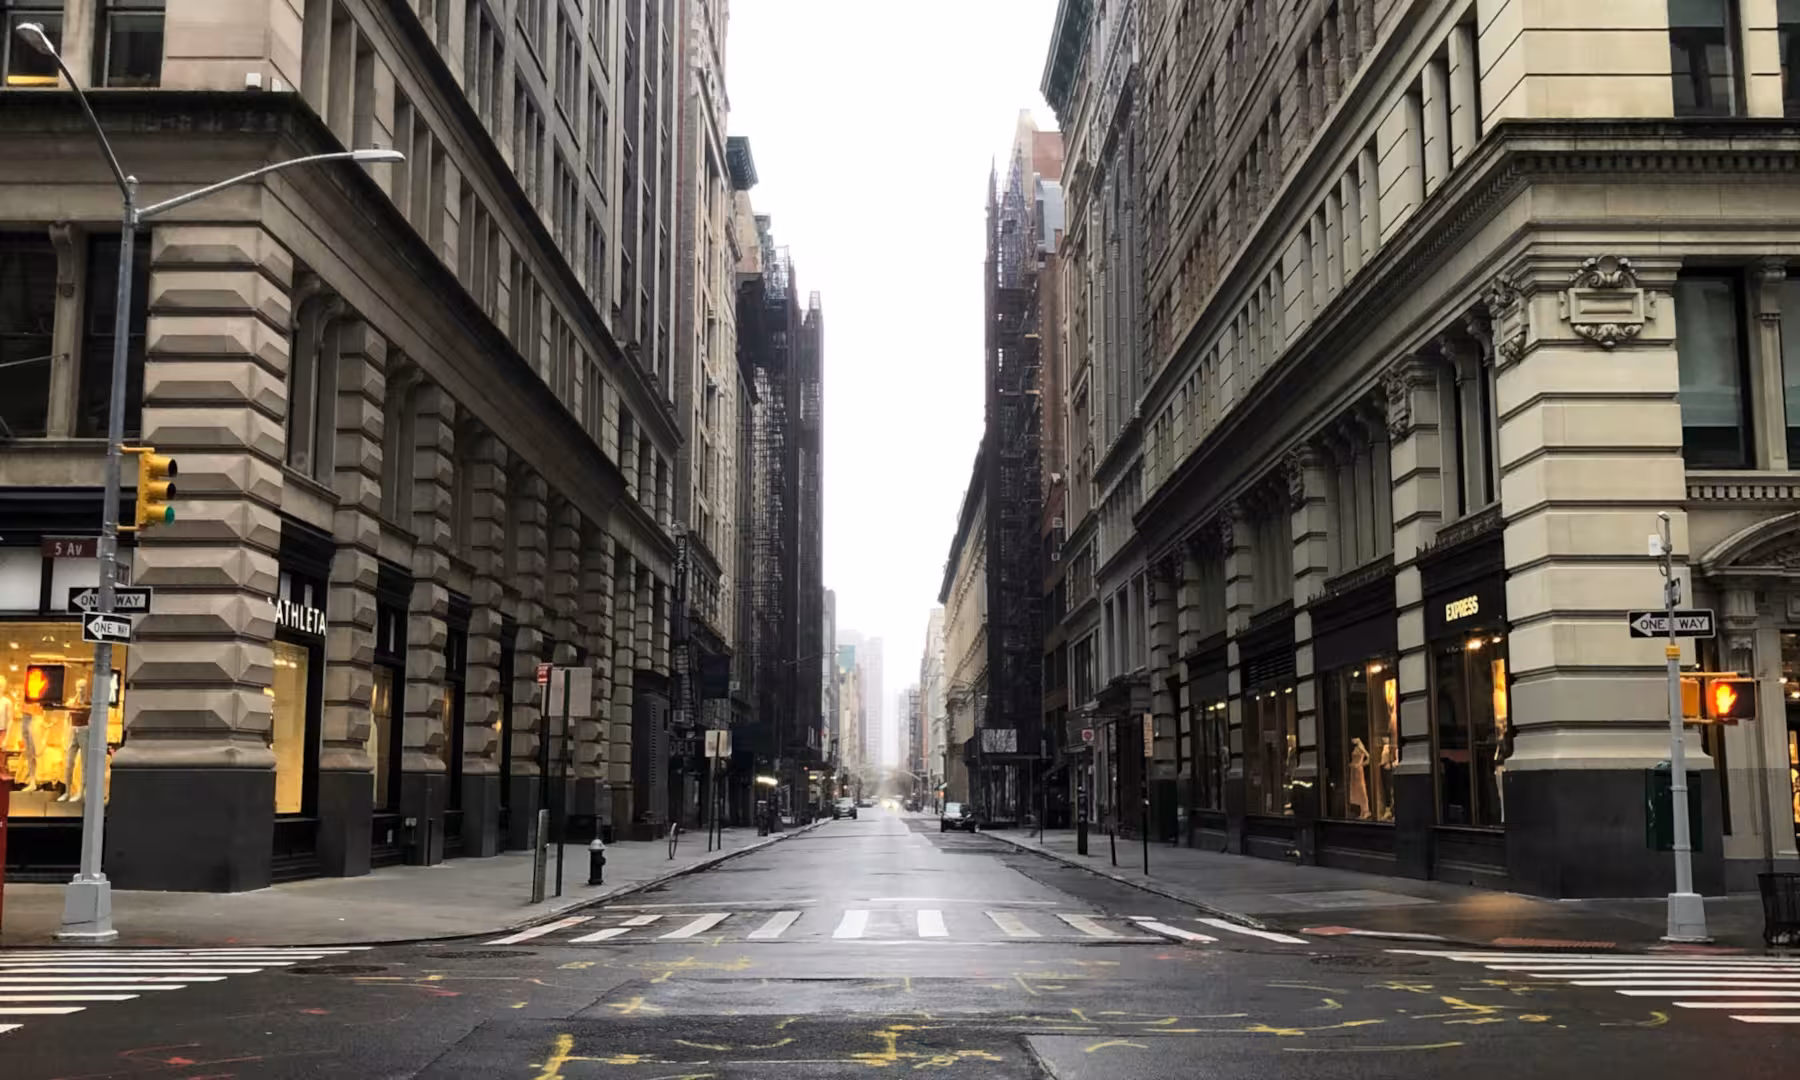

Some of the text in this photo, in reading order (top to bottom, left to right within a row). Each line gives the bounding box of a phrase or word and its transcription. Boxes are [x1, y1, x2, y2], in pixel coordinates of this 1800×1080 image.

[55, 542, 82, 556] 5 Av
[80, 595, 141, 606] ON WAY
[1445, 595, 1479, 622] EXPRESS
[274, 599, 327, 637] ATHLETA
[1640, 618, 1705, 630] ONE WAY
[93, 622, 113, 634] ONE
